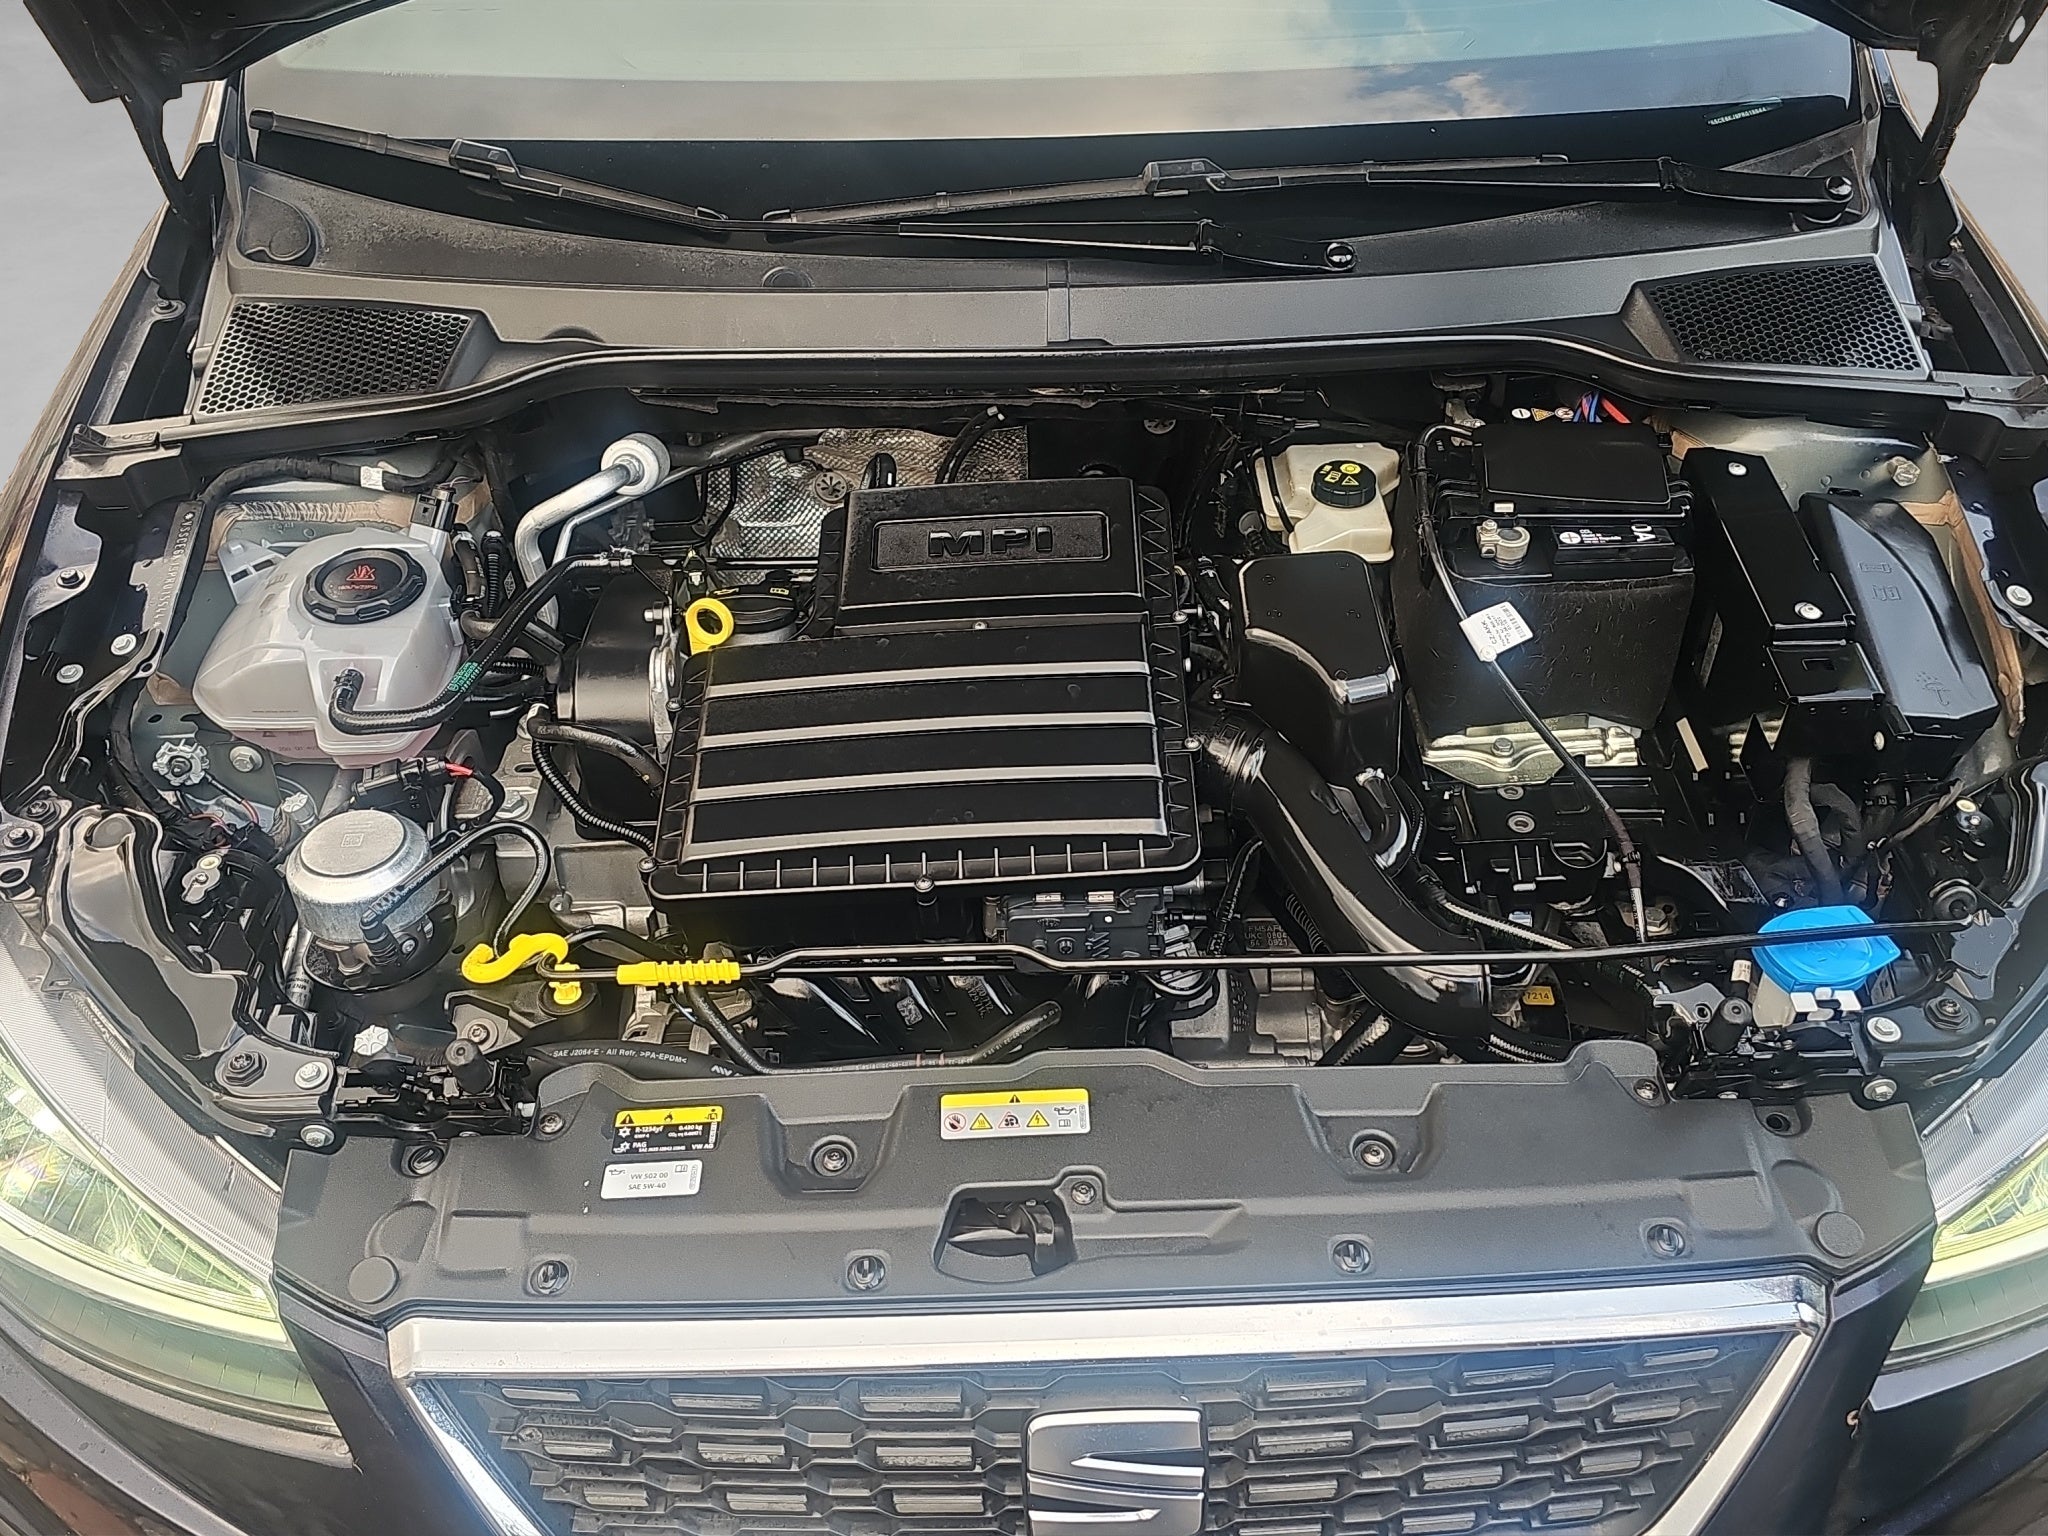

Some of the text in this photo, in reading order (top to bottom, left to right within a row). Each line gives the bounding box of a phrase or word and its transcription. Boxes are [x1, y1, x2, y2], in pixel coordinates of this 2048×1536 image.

[929, 526, 1053, 557] MPI
[553, 1050, 568, 1058] SAE
[632, 1141, 647, 1149] PAG
[628, 1181, 667, 1190] SAE 5W-40
